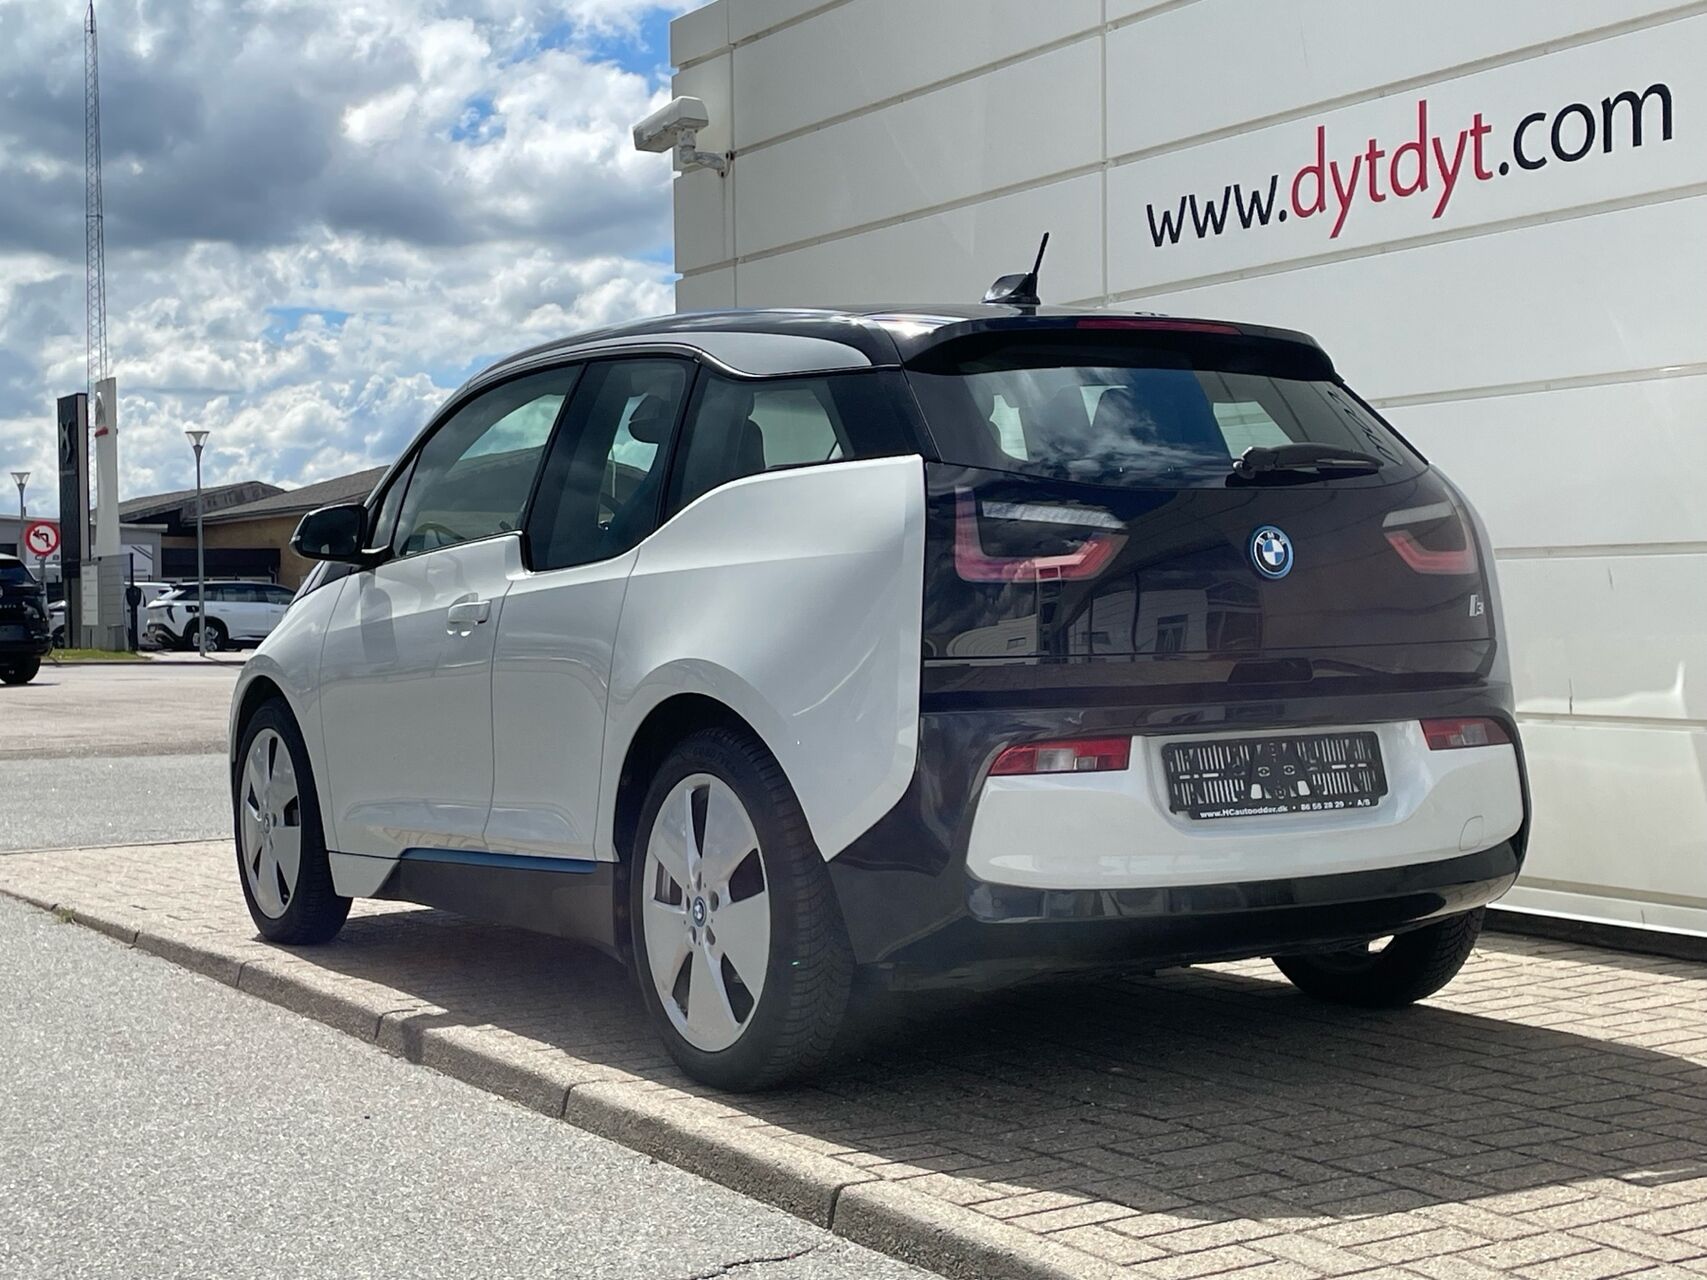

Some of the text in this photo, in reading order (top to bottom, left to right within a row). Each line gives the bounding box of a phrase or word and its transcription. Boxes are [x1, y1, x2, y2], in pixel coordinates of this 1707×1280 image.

[1146, 82, 1674, 247] www.dytdyt.com
[1257, 531, 1287, 545] BMW
[1334, 800, 1345, 808] 29
